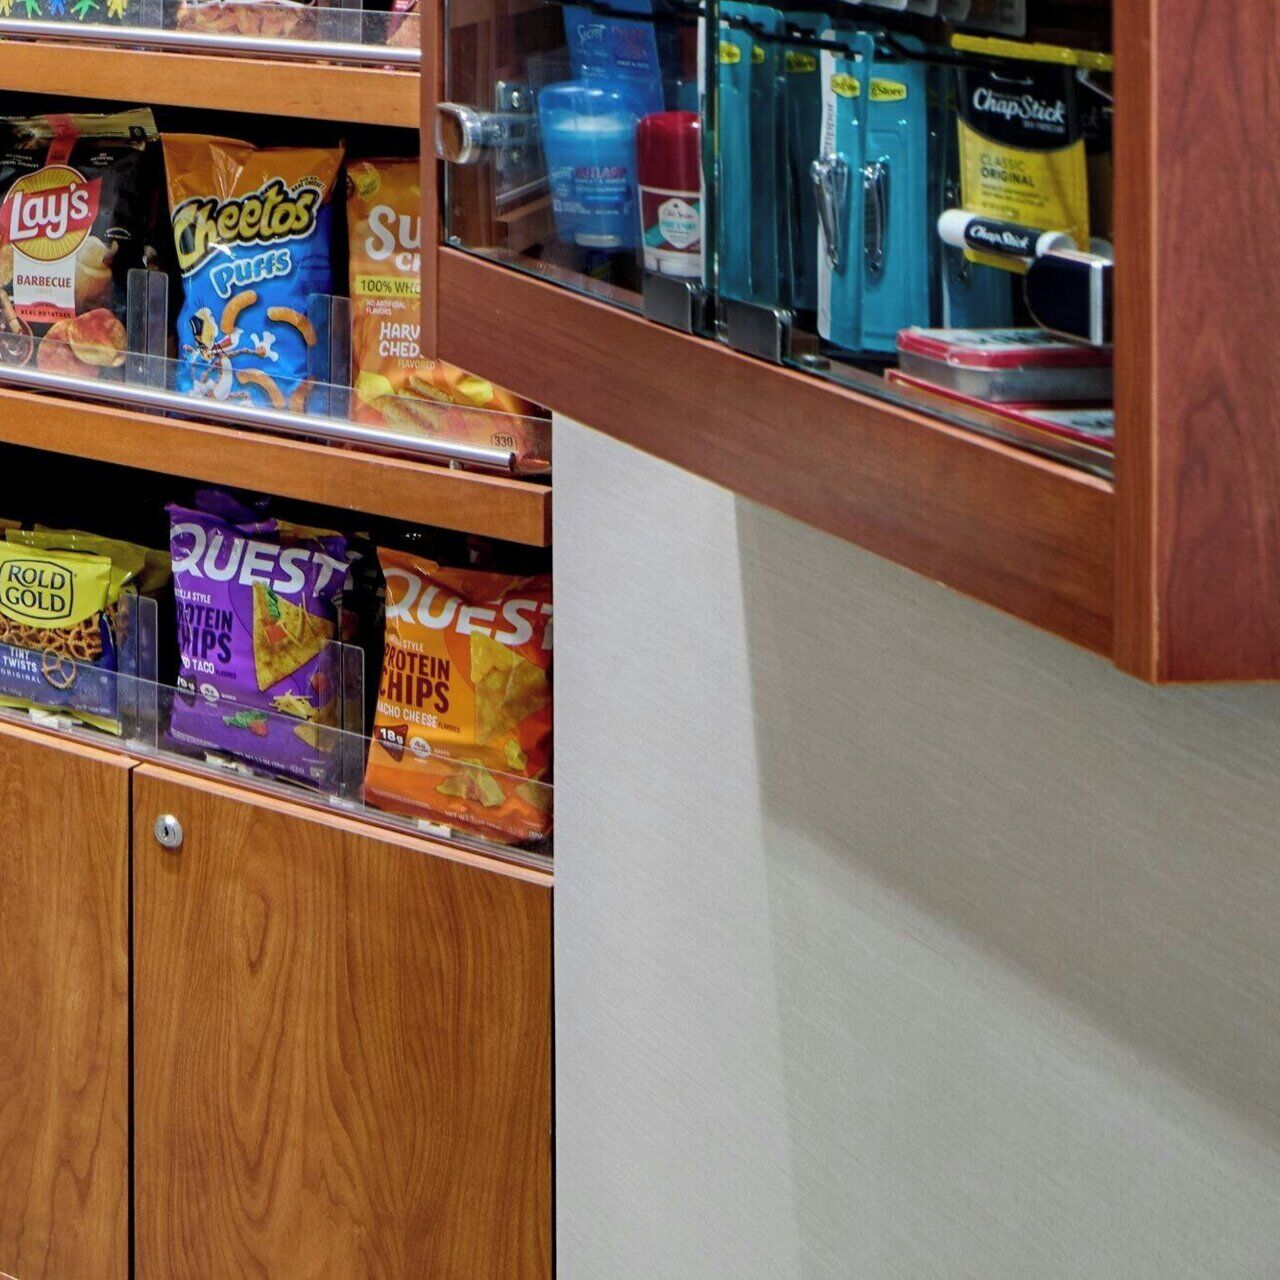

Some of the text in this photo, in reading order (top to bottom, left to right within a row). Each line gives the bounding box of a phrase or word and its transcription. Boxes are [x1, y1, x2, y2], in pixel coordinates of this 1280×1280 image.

[973, 88, 1065, 124] ChapStick
[980, 153, 1024, 171] CLASSIC
[981, 167, 1036, 188] ORIGINAL
[8, 182, 89, 241] Lay's
[173, 180, 319, 271] Cheetos
[968, 224, 1029, 250] ChapStick
[15, 275, 73, 290] BARBECUE
[360, 279, 394, 294] 100%
[397, 359, 436, 375] FLAVORED
[495, 434, 514, 448] 330
[170, 523, 349, 599] QUEST
[7, 563, 66, 590] ROLD
[4, 585, 66, 612] GOLD
[192, 590, 213, 606] STYLE
[9, 646, 31, 661] TINY
[402, 639, 424, 654] STYLE
[2, 655, 39, 671] TWISTS
[192, 657, 215, 675] TACO
[385, 643, 450, 681] PROTEIN
[1, 668, 42, 684] ORIGINAL
[403, 709, 438, 728] CHEESE
[380, 727, 405, 746] 18g
